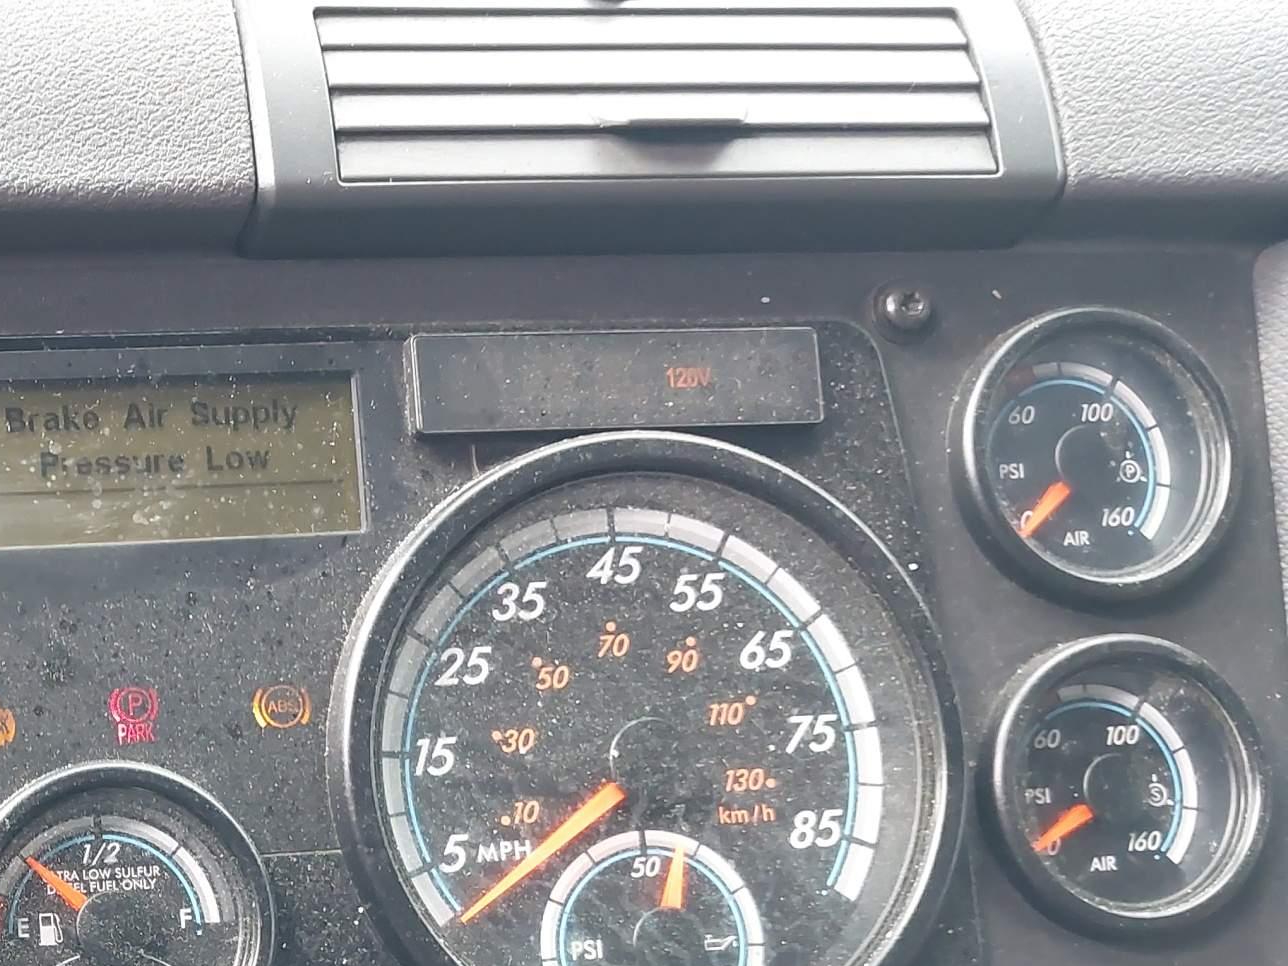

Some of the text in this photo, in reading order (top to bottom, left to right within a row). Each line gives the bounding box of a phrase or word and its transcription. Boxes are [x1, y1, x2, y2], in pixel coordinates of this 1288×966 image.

[4, 400, 297, 434] Brake Air Supply
[1008, 405, 1035, 425] 60
[1080, 403, 1113, 423] 100
[40, 446, 271, 479] Pressure Low
[999, 464, 1024, 480] PSI
[1101, 507, 1135, 527] 160
[1063, 531, 1090, 546] AIR
[585, 545, 644, 585] 45
[491, 581, 548, 622] 35
[669, 572, 726, 613] 55
[598, 634, 631, 658] 70
[739, 629, 794, 670] 65
[434, 646, 492, 686] 25
[667, 649, 698, 673] 90
[535, 665, 570, 690] 50
[708, 702, 746, 726] 110
[118, 723, 155, 745] PARK
[501, 728, 537, 754] 30
[785, 713, 838, 754] 75
[1034, 729, 1061, 749] 60
[1106, 725, 1139, 746] 100
[414, 736, 458, 776] 15
[724, 768, 764, 793] 130
[1024, 788, 1051, 804] PSI
[513, 800, 540, 825] 10
[718, 804, 775, 825] km/h
[789, 808, 844, 849] 85
[1128, 830, 1162, 851] 160
[82, 841, 121, 867] 1/2
[439, 834, 532, 874] 5 MPH
[1090, 856, 1118, 872] AIR
[83, 868, 112, 881] LOW
[115, 865, 161, 880] SULFUR
[630, 857, 662, 878] 50
[89, 879, 117, 894] FUEL
[121, 878, 157, 891] ONLY
[17, 918, 30, 938] E
[179, 908, 192, 929] F
[570, 940, 604, 960] PSI
